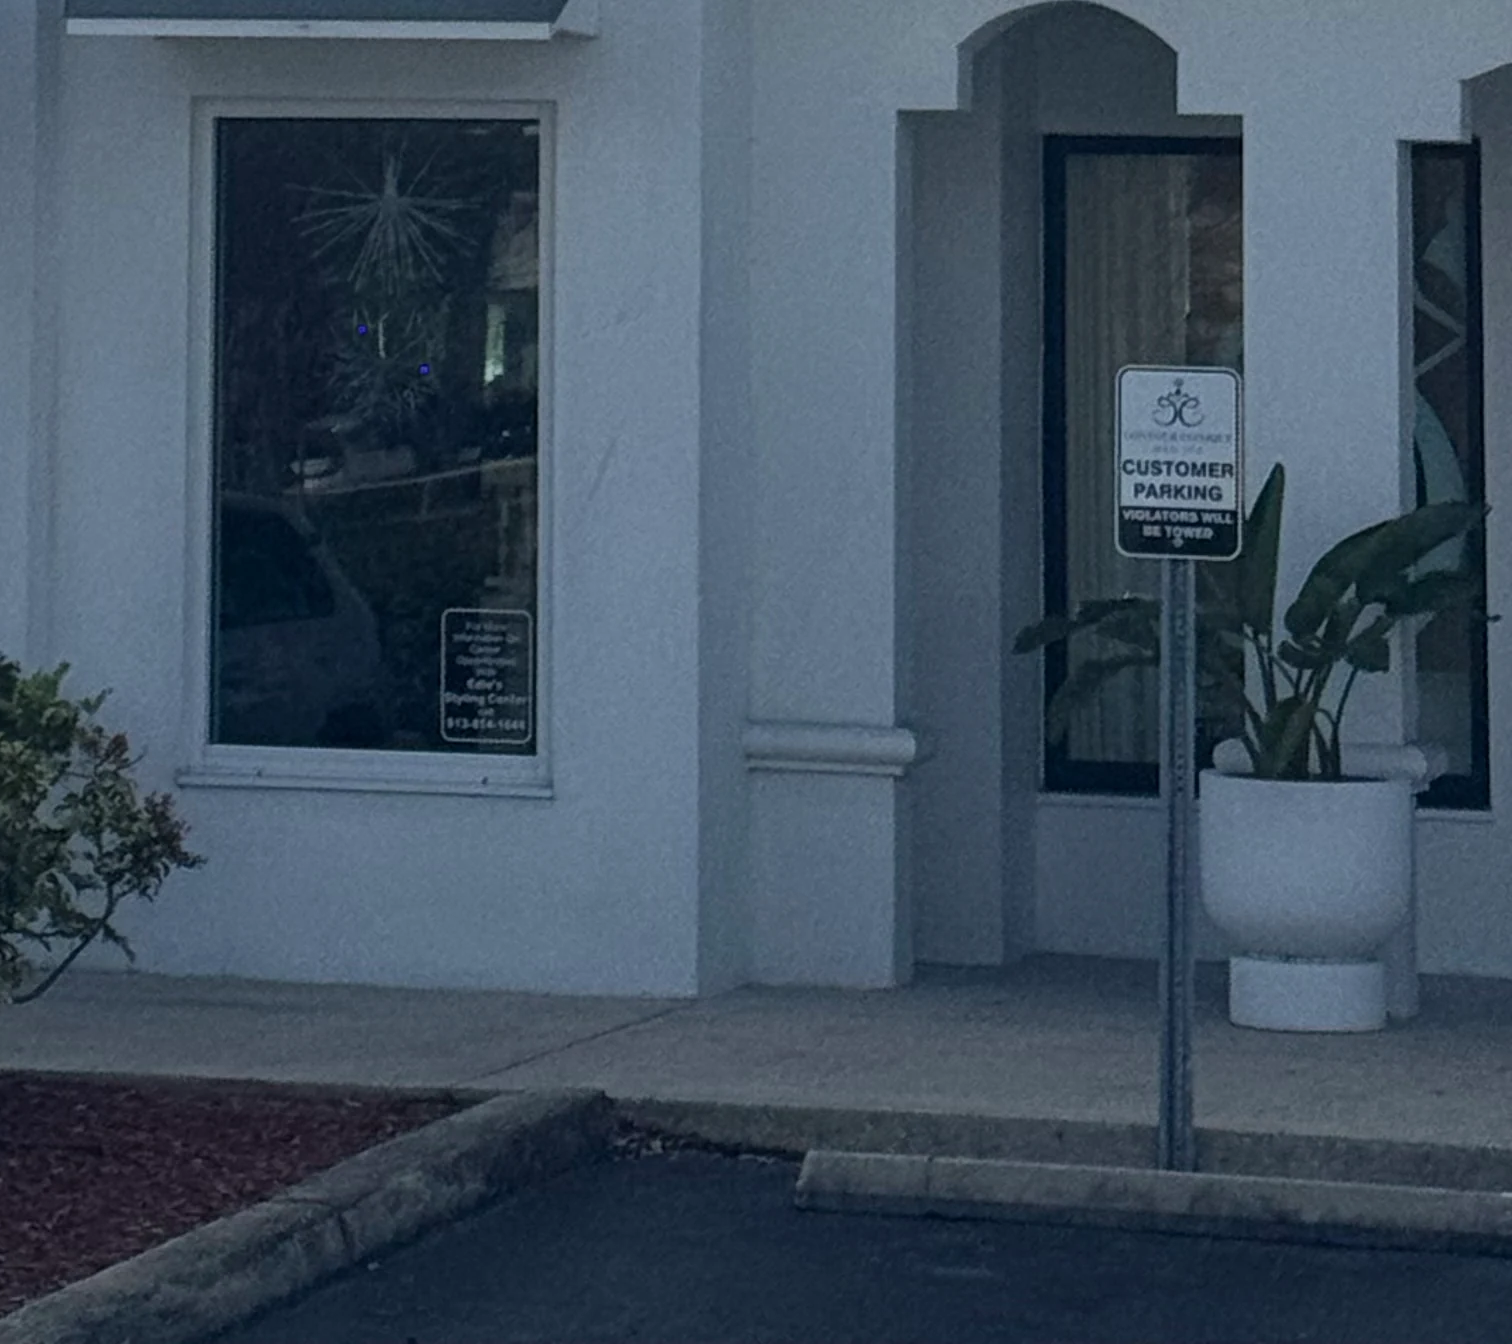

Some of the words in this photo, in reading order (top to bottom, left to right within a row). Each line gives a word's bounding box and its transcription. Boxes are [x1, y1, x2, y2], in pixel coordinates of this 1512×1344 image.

[1122, 459, 1234, 478] CUSTOMER
[1133, 483, 1223, 501] PARKING
[1122, 509, 1199, 524] VIOLATORS
[1201, 512, 1234, 525] WILL
[1142, 524, 1162, 538] BE
[1164, 525, 1214, 540] TOWED
